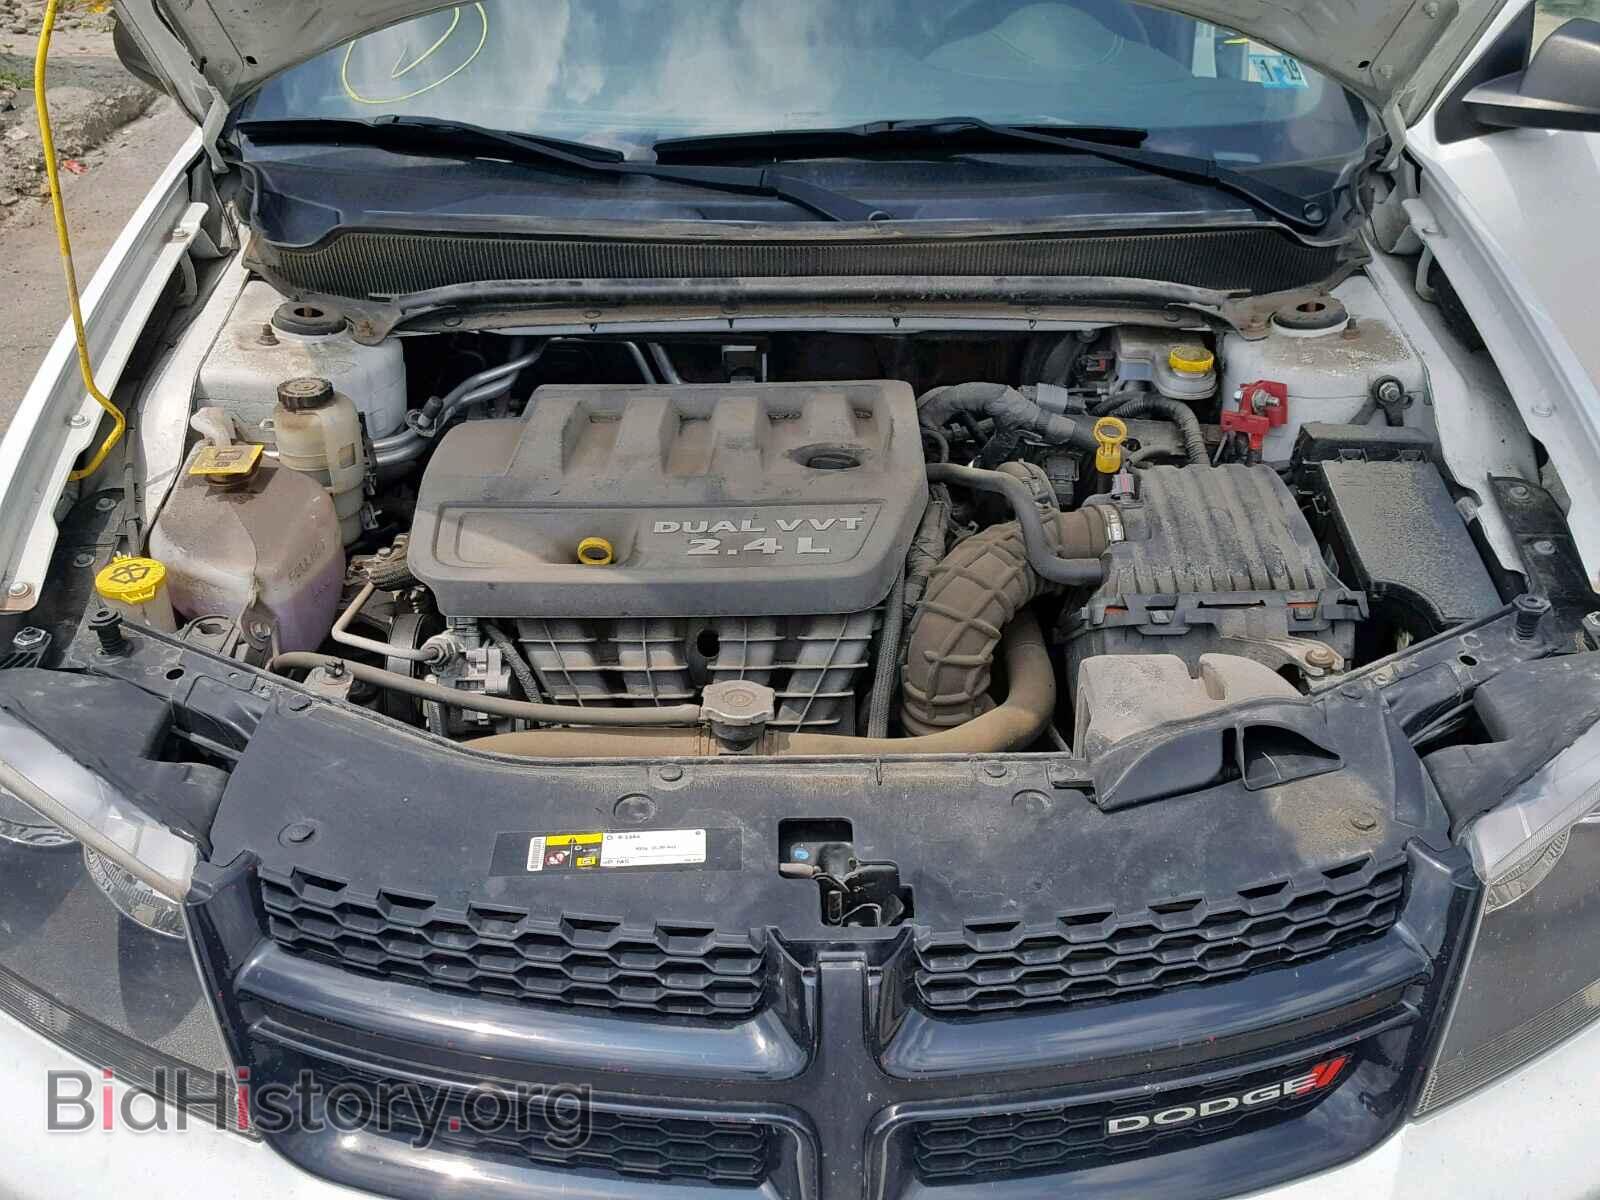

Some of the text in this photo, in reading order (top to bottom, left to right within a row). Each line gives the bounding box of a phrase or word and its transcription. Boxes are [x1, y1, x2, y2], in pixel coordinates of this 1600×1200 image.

[653, 516, 864, 534] DUAL VVT
[1107, 1072, 1318, 1135] DODGE
